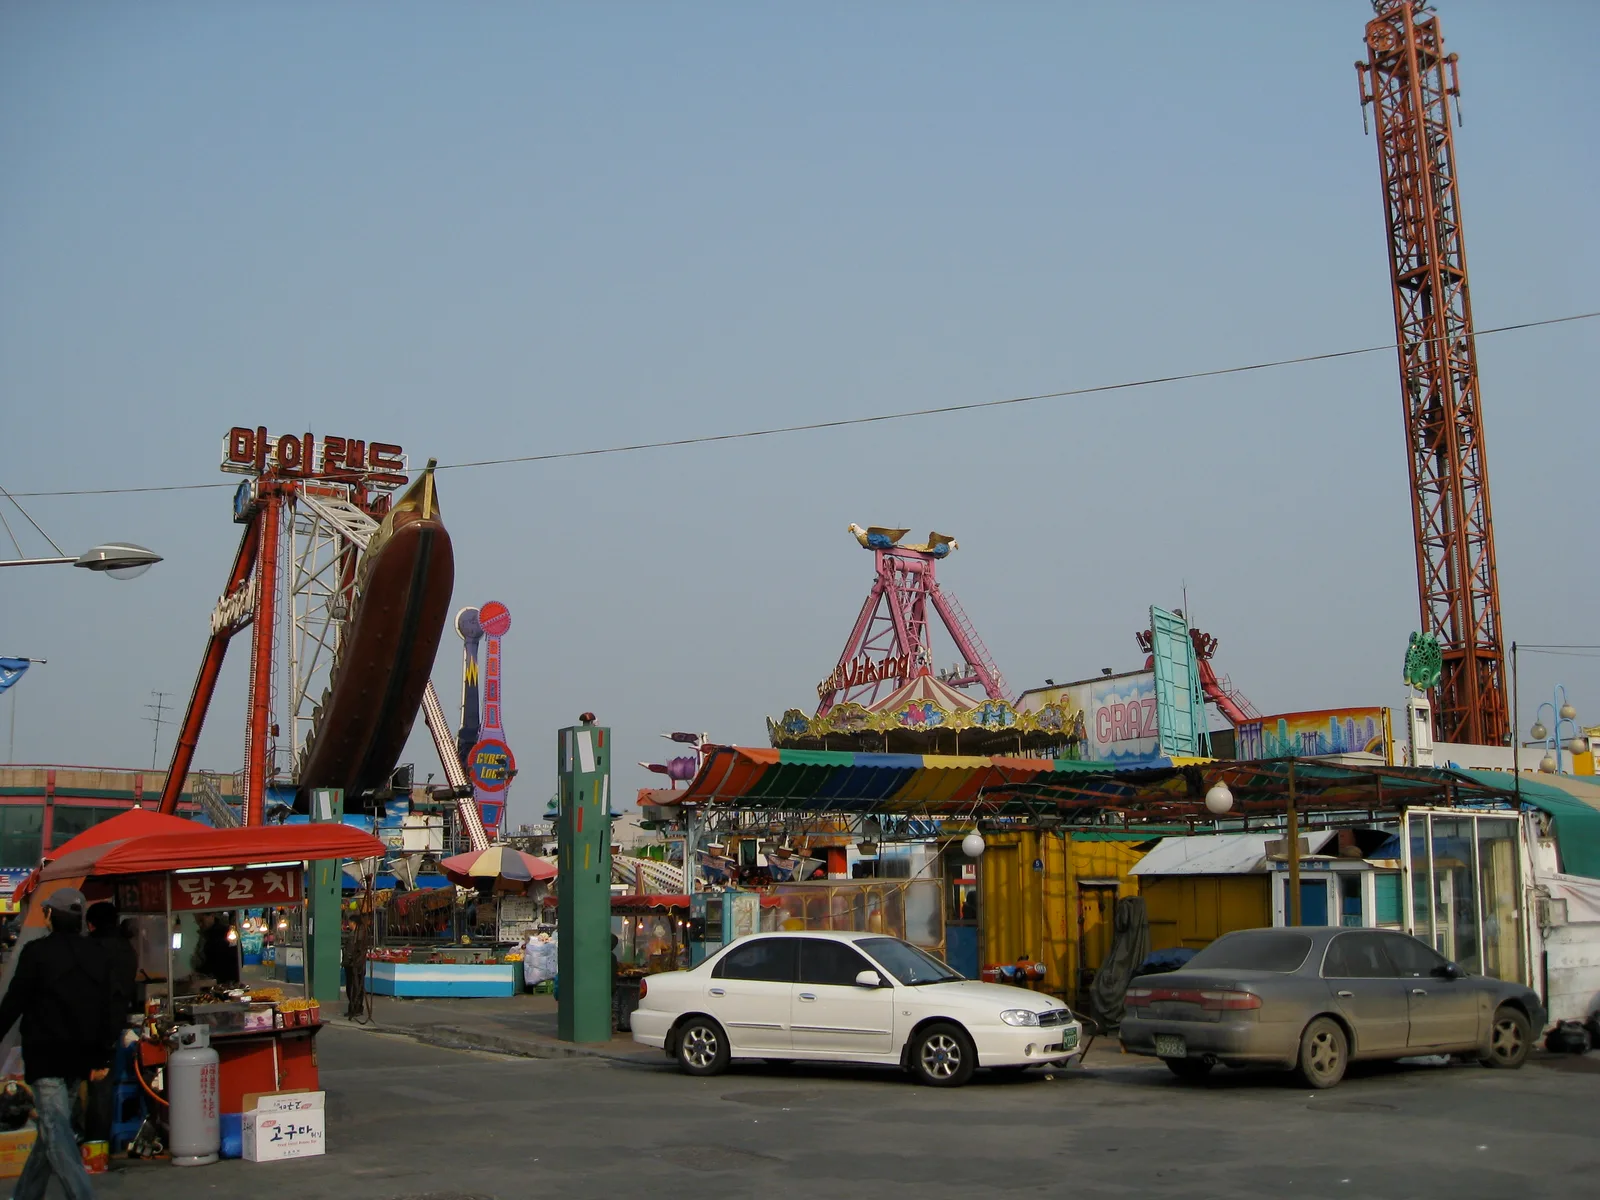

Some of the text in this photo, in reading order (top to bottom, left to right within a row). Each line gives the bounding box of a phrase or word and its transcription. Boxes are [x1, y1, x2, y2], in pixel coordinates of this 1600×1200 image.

[229, 426, 409, 485] 마이랜드
[841, 652, 911, 690] Viking
[178, 871, 294, 906] 닭꼬치
[270, 1124, 313, 1142] 고구마
